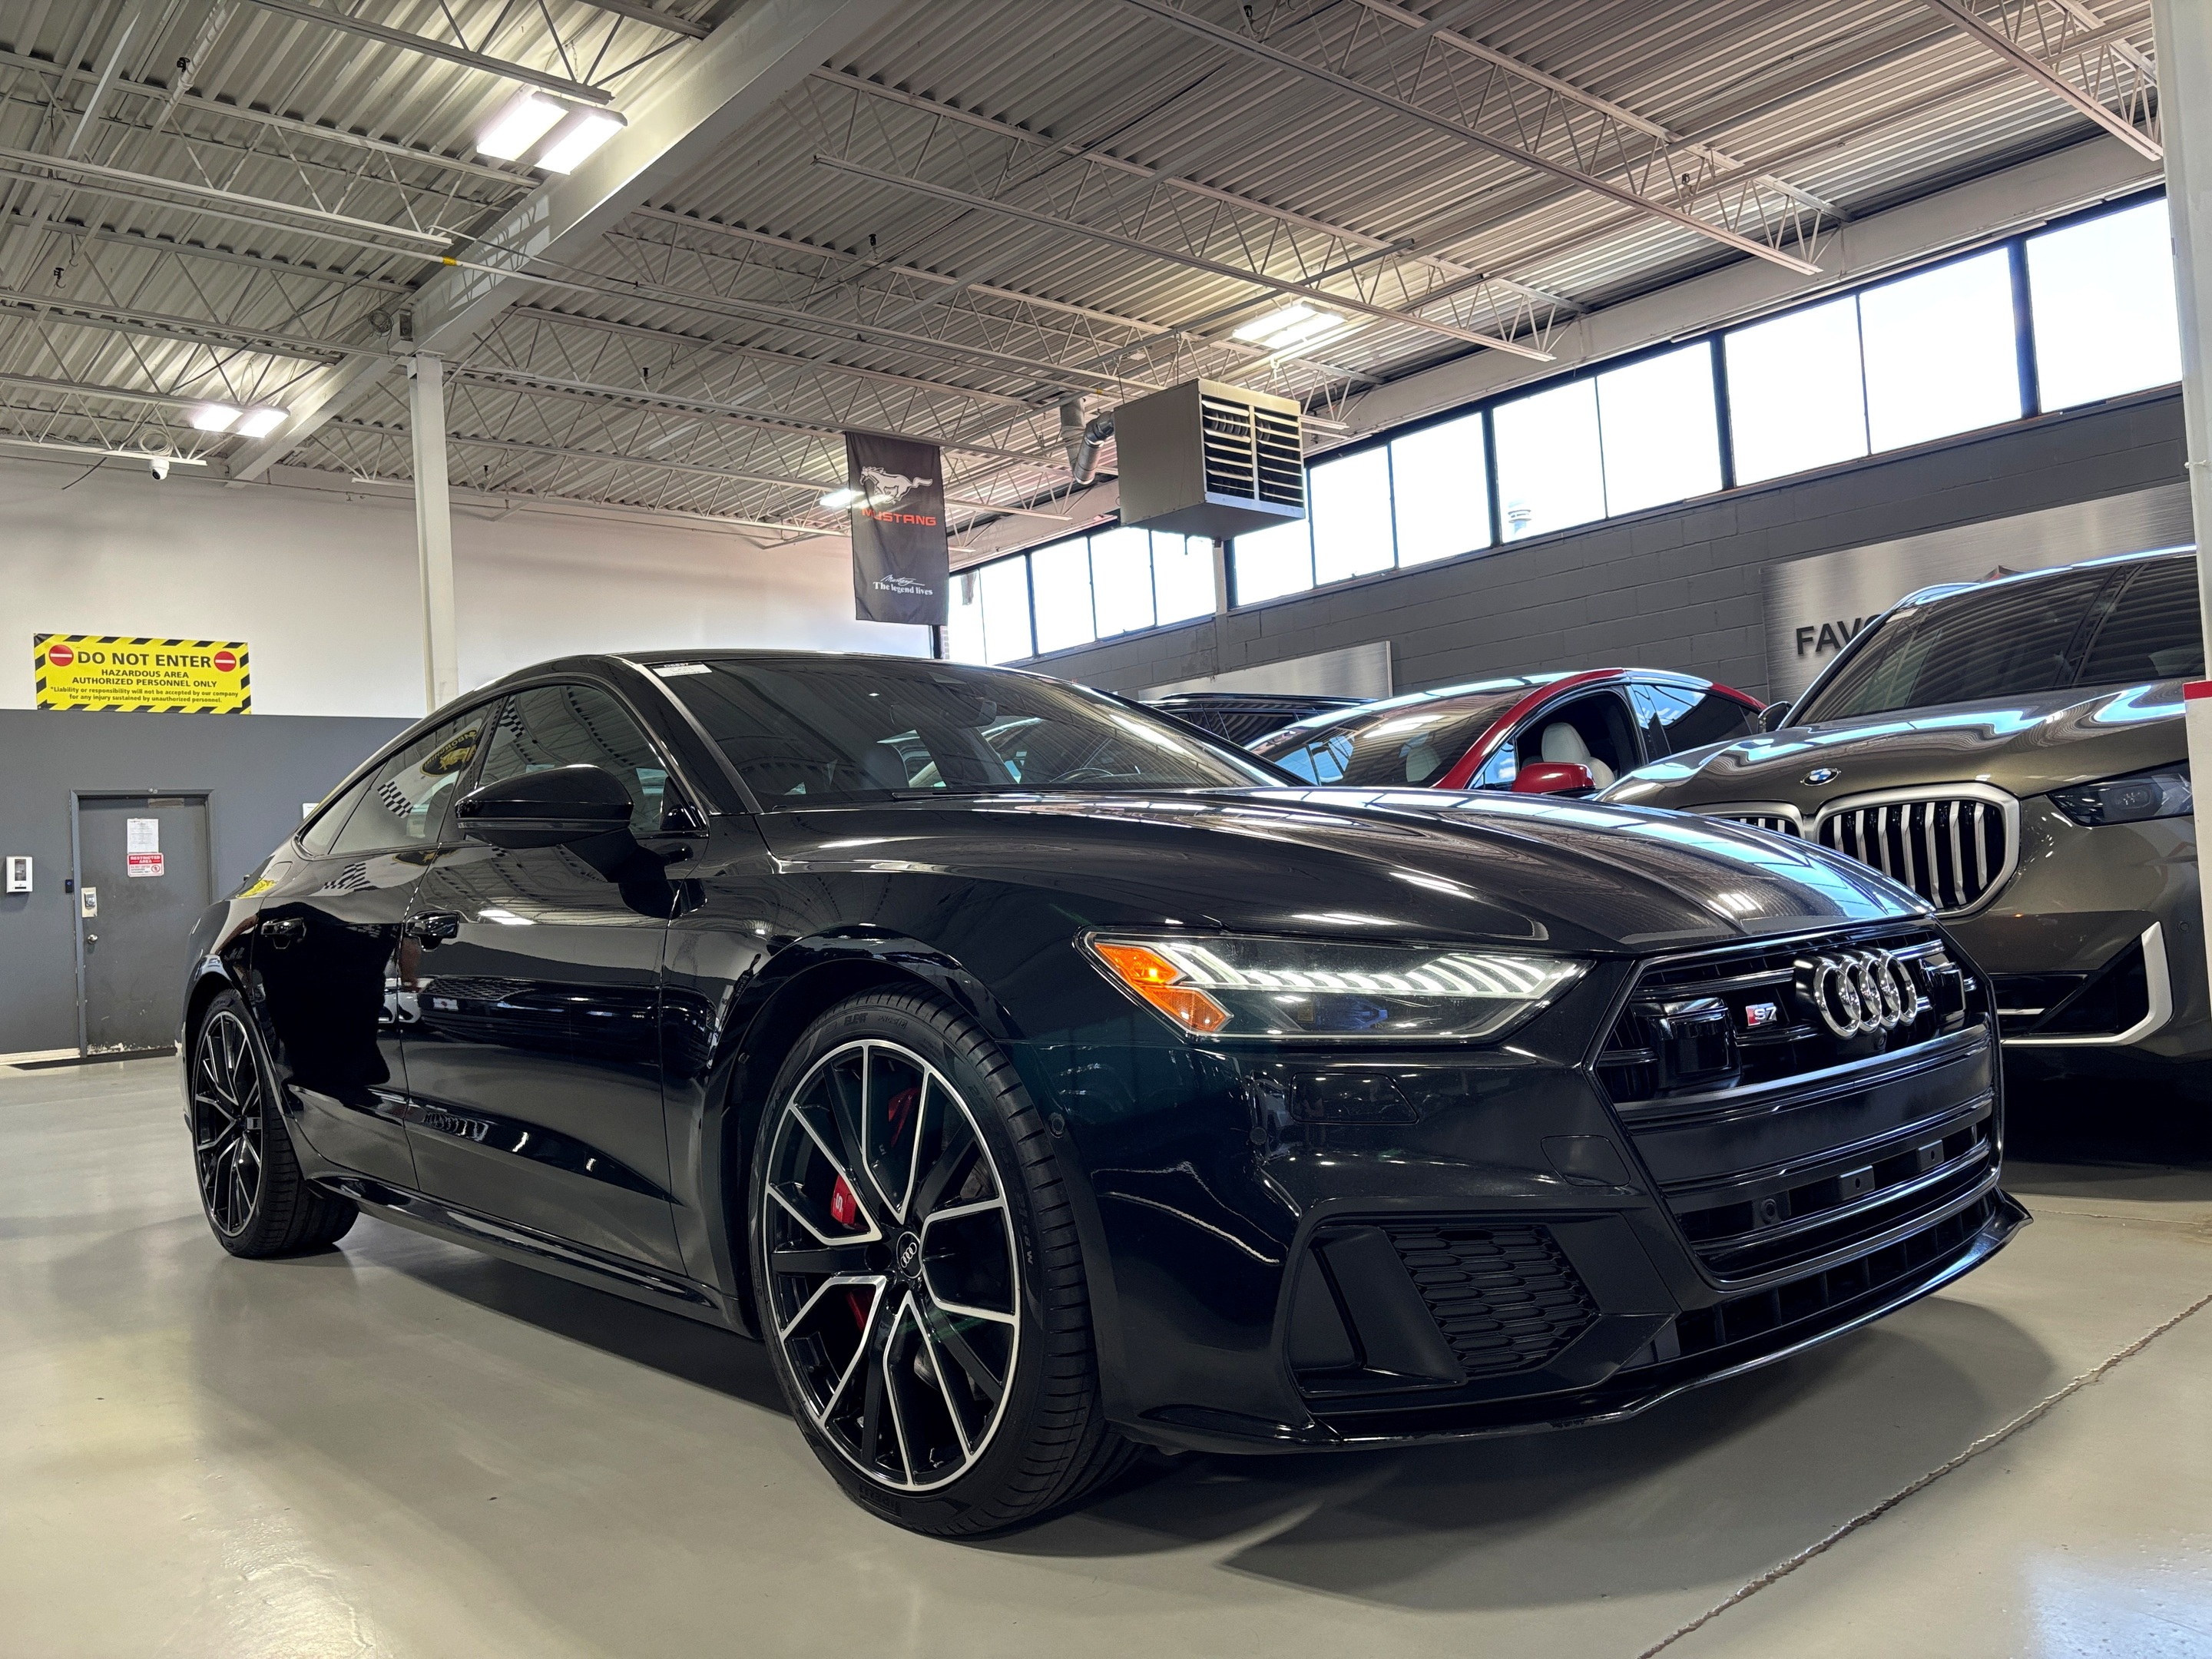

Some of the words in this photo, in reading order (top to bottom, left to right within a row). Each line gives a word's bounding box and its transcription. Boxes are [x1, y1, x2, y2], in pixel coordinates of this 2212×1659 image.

[861, 508, 936, 526] MUSTANG
[873, 581, 890, 590] The
[891, 584, 914, 594] legend
[916, 586, 933, 595] lives
[78, 651, 105, 664] DO
[112, 653, 149, 666] NOT
[155, 654, 211, 668] ENTER
[101, 669, 161, 677] HAZARDOUS
[72, 677, 133, 685] AUTHORIZED
[137, 679, 190, 687] PERSONNEL
[1754, 1005, 1777, 1020] S7
